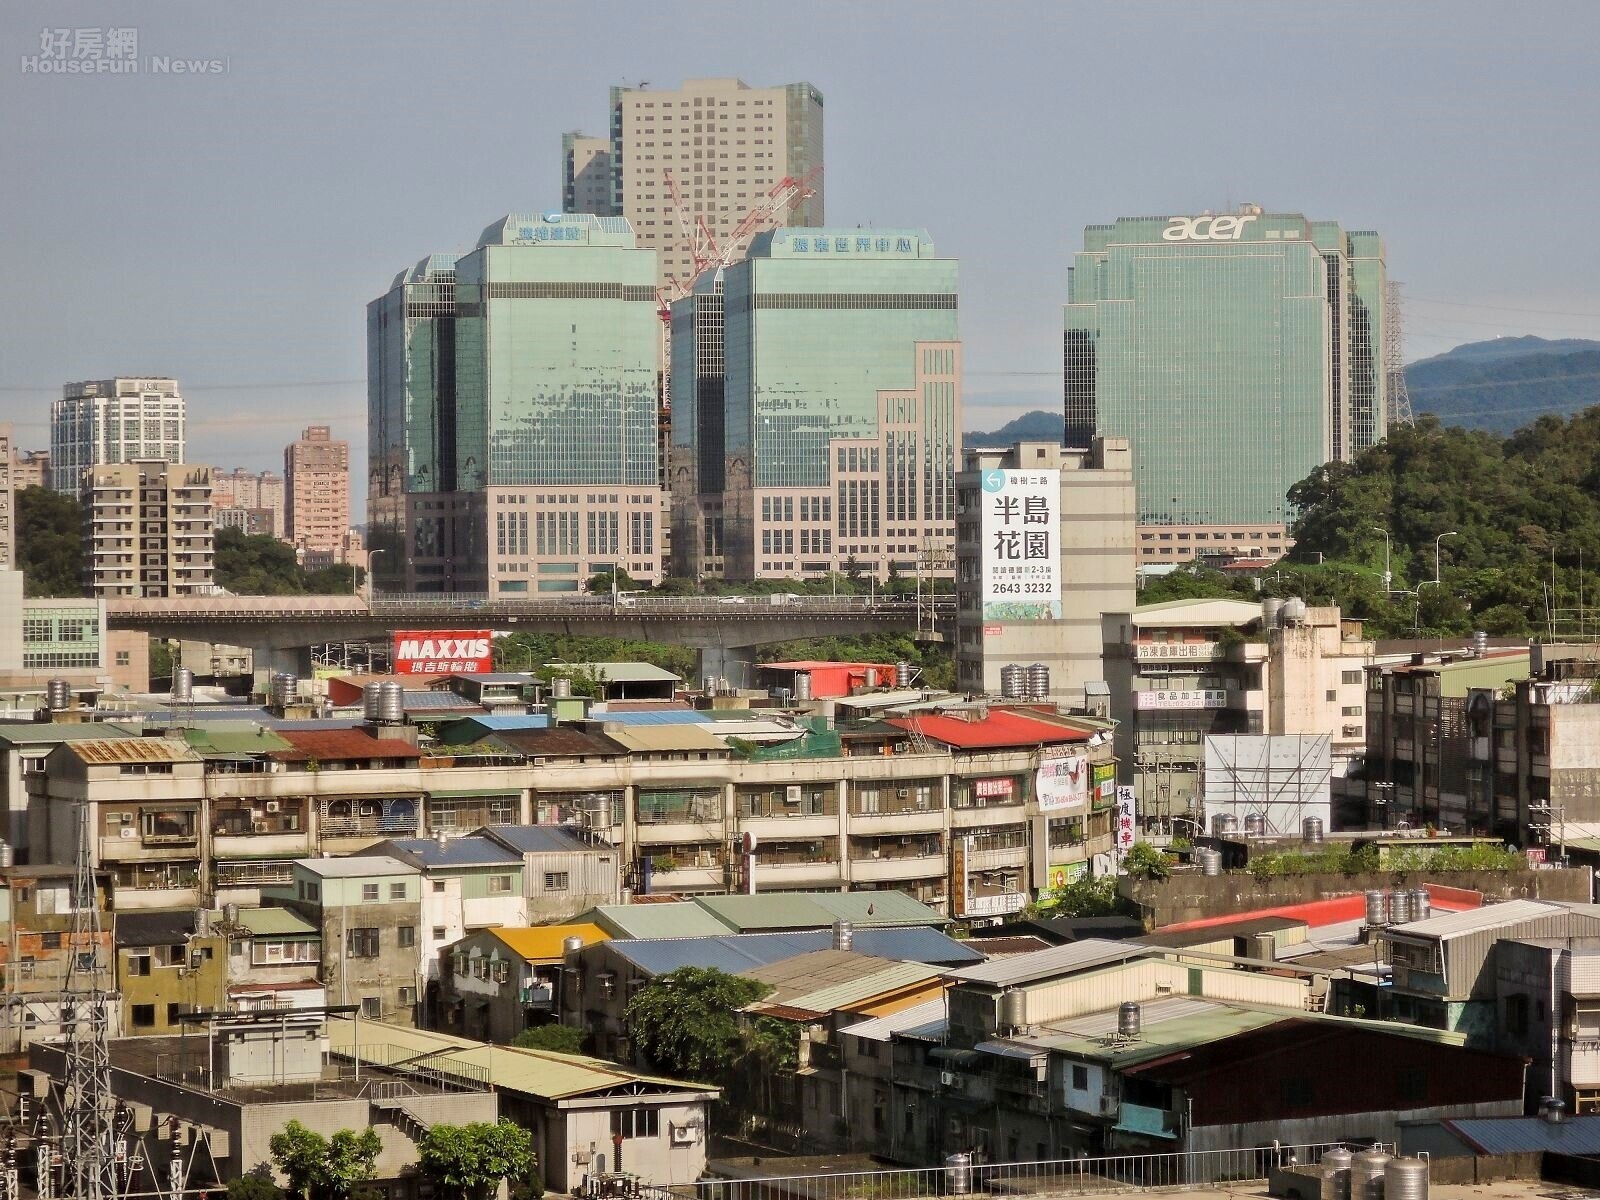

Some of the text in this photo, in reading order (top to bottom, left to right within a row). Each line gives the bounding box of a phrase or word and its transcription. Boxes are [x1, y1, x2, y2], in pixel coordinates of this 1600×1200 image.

[1162, 216, 1257, 241] acer
[994, 496, 1050, 525] 半島
[994, 530, 1050, 560] 花園
[992, 582, 1052, 594] 2643 3232
[397, 639, 490, 660] MAXXIS
[1139, 645, 1198, 657] 冷凍倉庫出租
[411, 661, 478, 673] 瑪吉斯輪胎
[1119, 786, 1134, 846] 極度機車
